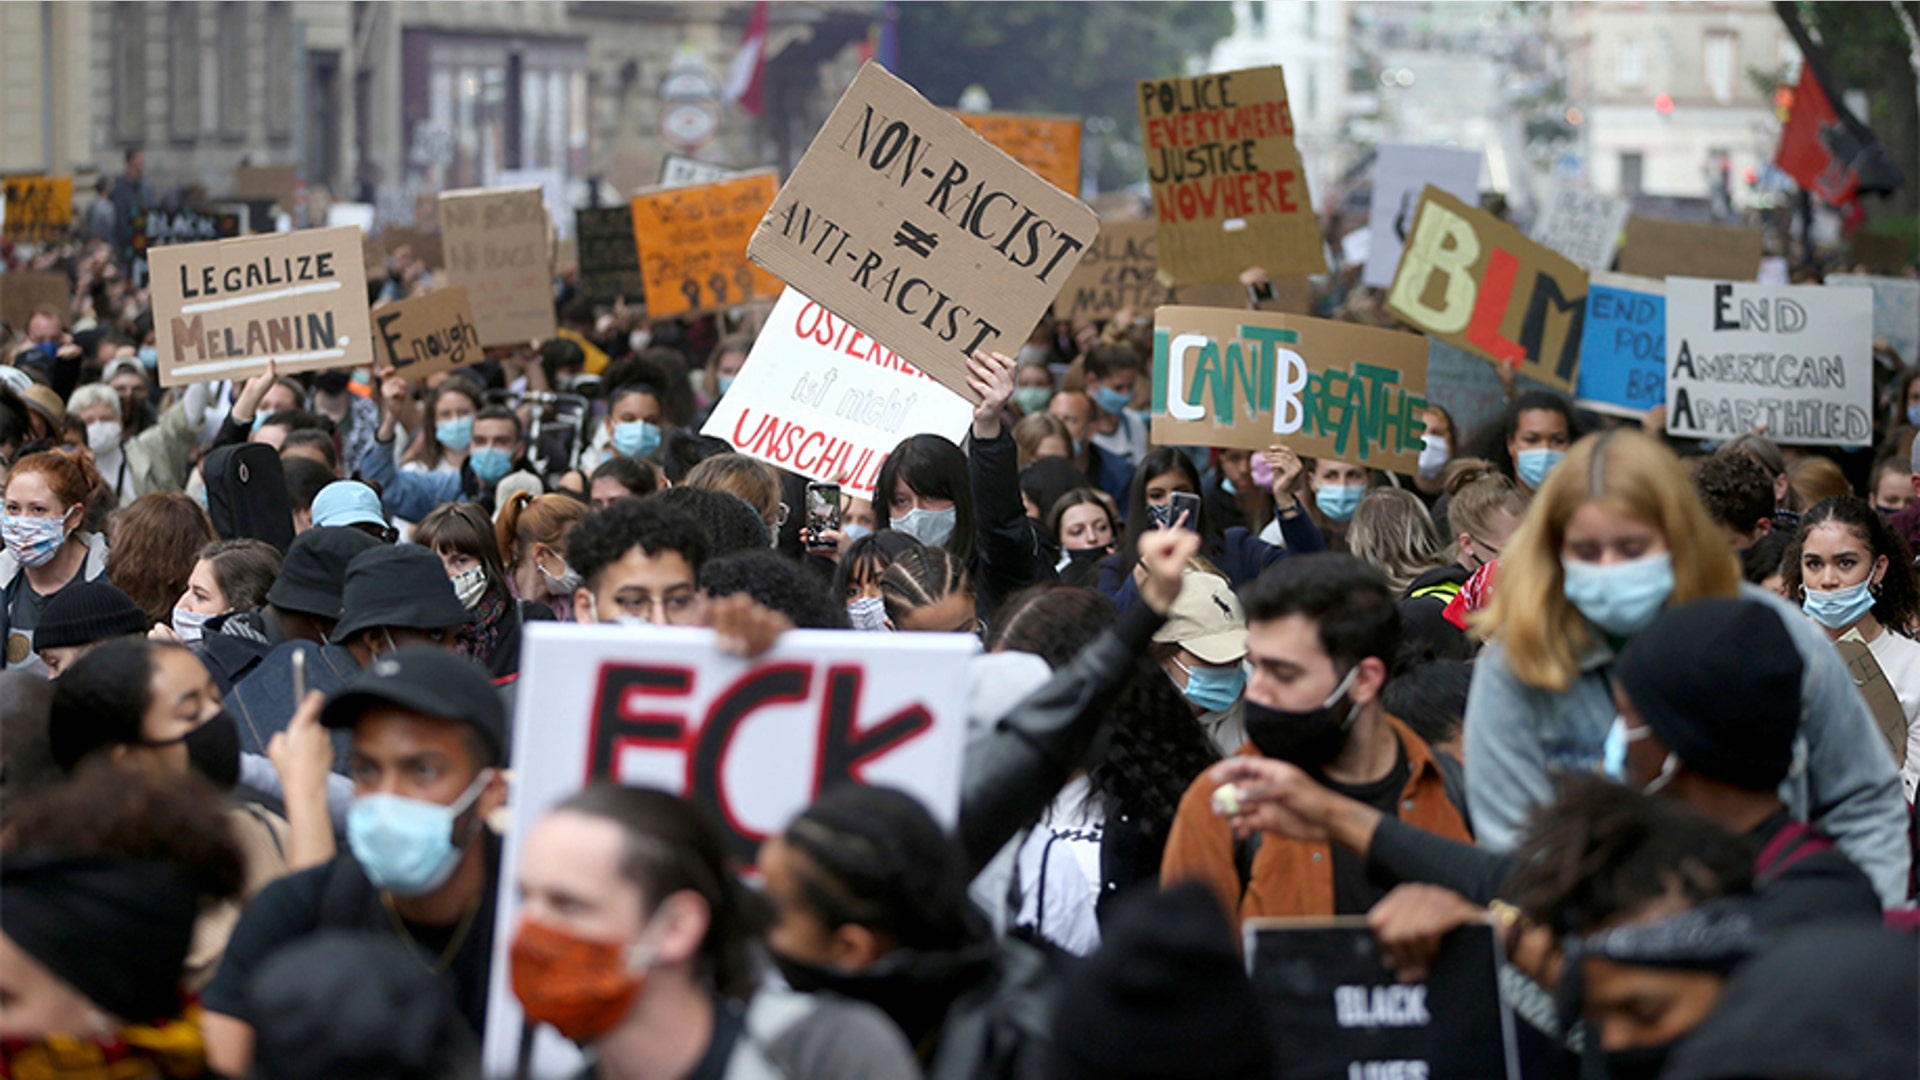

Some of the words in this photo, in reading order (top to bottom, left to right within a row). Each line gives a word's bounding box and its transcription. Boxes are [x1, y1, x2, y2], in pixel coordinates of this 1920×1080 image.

[1141, 76, 1238, 116] POLICE
[1147, 100, 1293, 148] EVERYWHERE
[1150, 141, 1259, 183] JUSTICE
[840, 103, 1084, 285] NON-RACIST
[1157, 171, 1299, 224] NOWHERE
[180, 252, 335, 299] LEGALIZE
[767, 200, 1002, 358] ANTI-RACIST
[1388, 199, 1588, 382] BLM
[1592, 294, 1655, 325] END
[1714, 284, 1807, 333] END
[377, 312, 480, 369] Enough
[1672, 338, 1846, 389] AMERICAN
[790, 367, 838, 409] ist
[835, 388, 918, 435] nicht
[1333, 984, 1431, 1027] BLACK
